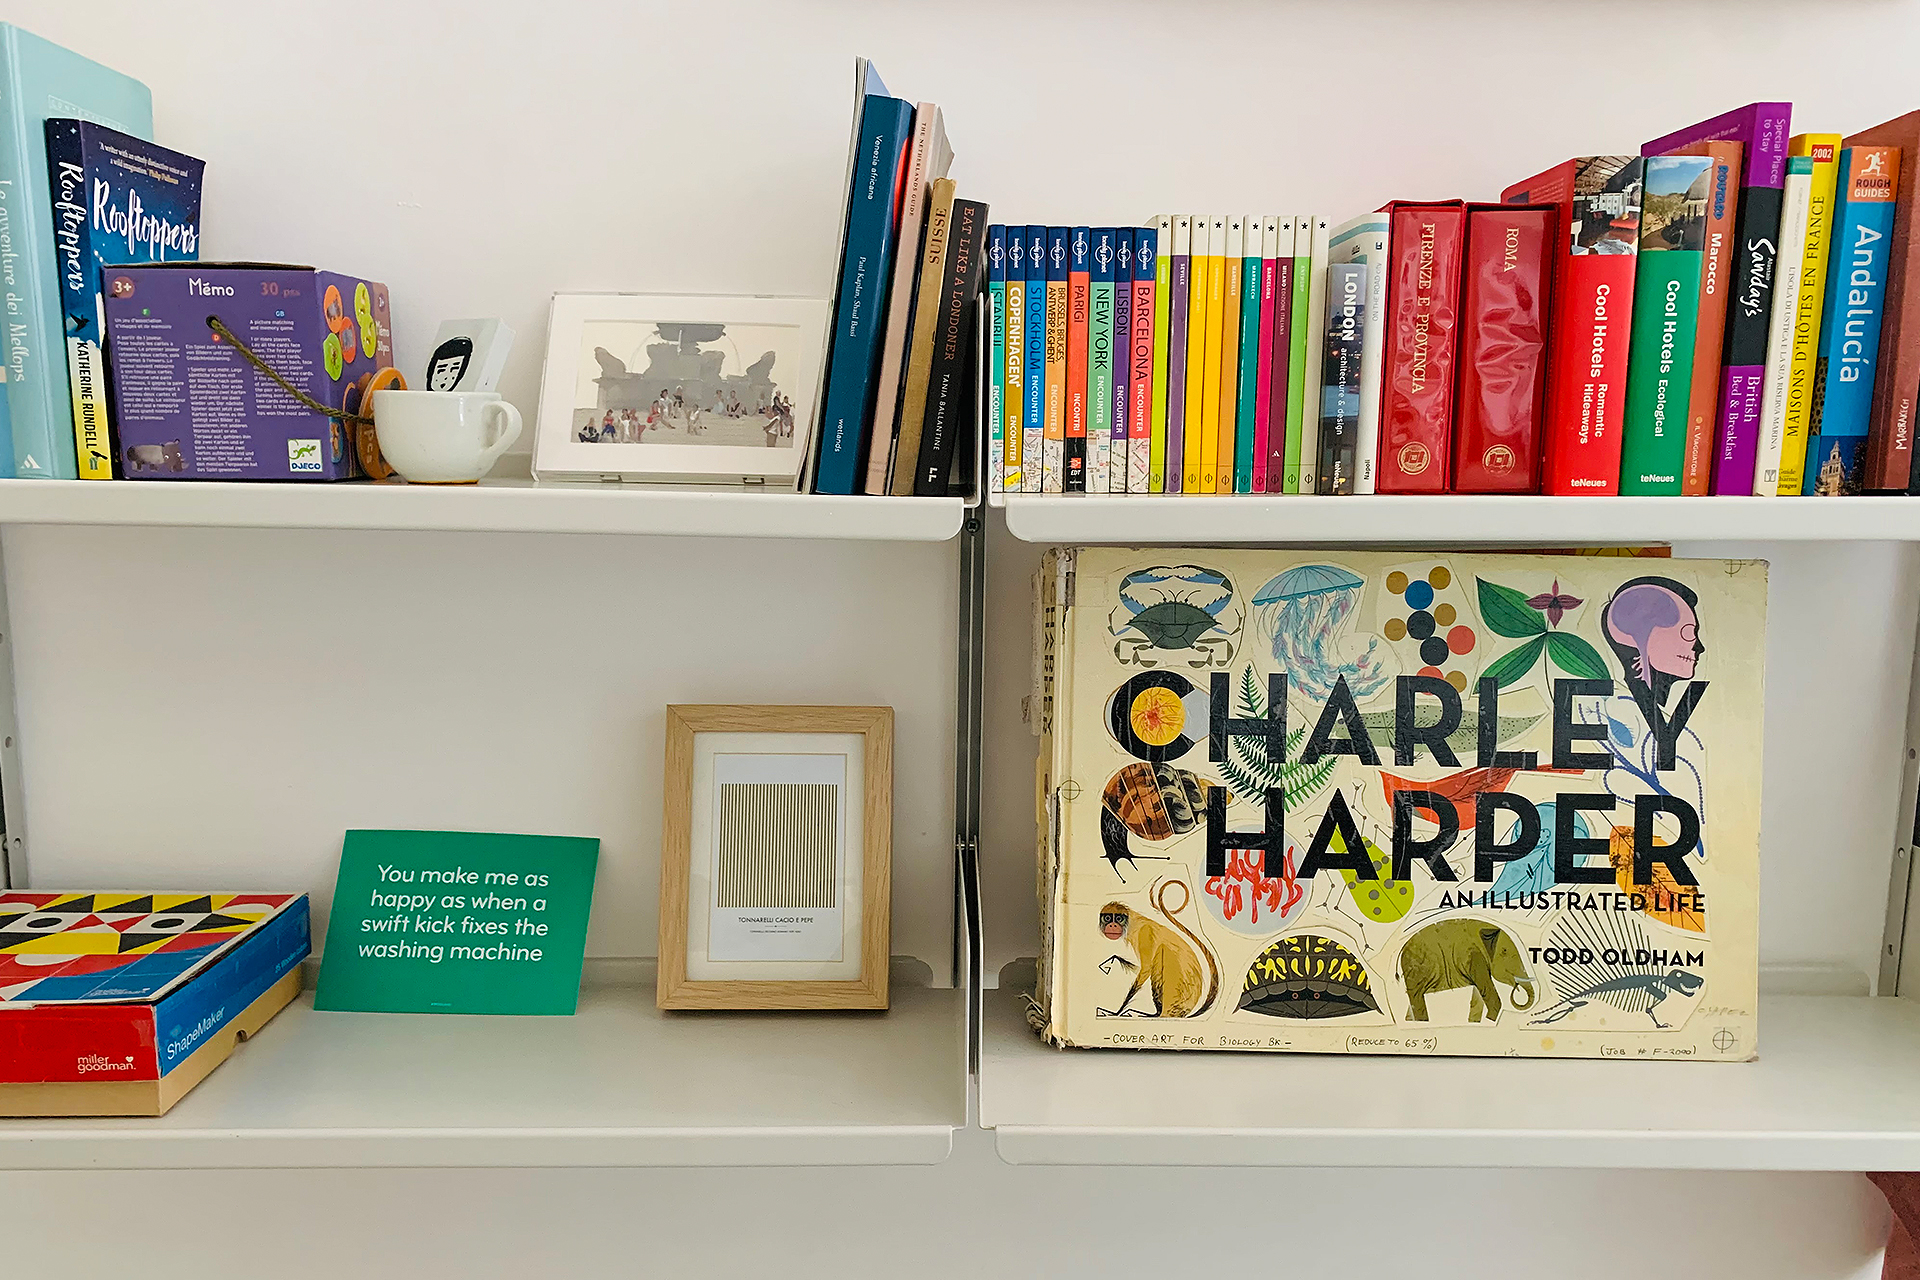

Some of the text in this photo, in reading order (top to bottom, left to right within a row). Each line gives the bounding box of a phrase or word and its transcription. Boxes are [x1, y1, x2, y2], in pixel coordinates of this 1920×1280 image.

[1759, 118, 1773, 153] to Stay
[1769, 118, 1786, 185] Special Places
[1812, 148, 1833, 159] 2002
[868, 134, 884, 200] Venezia africana
[913, 138, 924, 191] NETHERLANDS
[1855, 178, 1891, 188] ROUGH
[909, 193, 917, 217] GUIDE
[1854, 188, 1890, 198] GUIDES
[55, 161, 87, 296] Rooftoppers
[94, 177, 199, 262] Rooftoppers
[929, 207, 947, 265] SUISSE
[0, 207, 19, 286] avventure
[1503, 227, 1520, 273] ROMA
[1706, 233, 1723, 295] Marocco
[114, 280, 132, 294] 3+
[188, 277, 235, 297] Mémo
[260, 282, 279, 296] 30
[850, 256, 867, 338] Paul Kaplan, Shaul Bassi
[944, 206, 975, 361] EAT LIKE A LONDONER
[1373, 275, 1381, 295] ROAD
[1740, 237, 1776, 318] Sawday's
[6, 292, 23, 316] dei
[1047, 286, 1057, 328] ANTWERP
[1073, 285, 1085, 323] PARIGI
[1116, 288, 1129, 336] LISBON
[1341, 273, 1358, 341] LONDON
[1371, 310, 1379, 322] ON
[1411, 223, 1436, 394] FIRENZE E PROVINCIA
[1787, 195, 1824, 437] MAISONS D'HÔTES EN FRANCE
[1839, 224, 1882, 382] Andalucía
[1008, 286, 1021, 386] COPENHAGEN
[1029, 286, 1042, 370] STOCKHOLM
[1046, 335, 1055, 364] GHENT
[1094, 288, 1110, 370] NEW YORK
[1135, 287, 1150, 380] BARCELONA
[9, 323, 30, 382] Mellops
[1338, 347, 1348, 398] architecture
[1590, 284, 1610, 438] Cool Hotels Romantic
[1654, 280, 1681, 437] Cool Hotels Ecological
[76, 342, 98, 449] KATHERINE RUNDELL
[933, 373, 951, 451] TANIA BALLANTINE
[1031, 375, 1039, 424] ENCOUNTER
[1050, 384, 1058, 433] ENCOUNTER
[1073, 392, 1081, 431] INCONTRI
[1096, 375, 1105, 424] ENCOUNTER
[1115, 385, 1124, 434] ENCOUNTER
[1136, 383, 1145, 432] ENCOUNTER
[1579, 383, 1594, 445] Hideaways
[1724, 375, 1743, 460] Bed & Breakfast
[1743, 376, 1761, 422] British
[834, 418, 844, 453] wetlands
[1009, 415, 1017, 462] ENCOUNTER
[1335, 408, 1345, 435] design
[1770, 416, 1780, 450] MARINA
[1895, 398, 1910, 450] MARRAKECH
[291, 462, 321, 470] DJECO
[1363, 459, 1372, 481] Napoli
[1690, 433, 1702, 476] VIAGGIATORE
[1570, 478, 1607, 488] teNeues
[1640, 474, 1675, 484] teNeues
[1110, 670, 1710, 773] CHARLEY
[1204, 785, 1706, 887] HARPER
[377, 864, 549, 887] You make me as
[370, 889, 547, 912] happy as when a
[1438, 890, 1706, 913] AN ILLUSTRATED LIFE
[360, 914, 549, 936] swift kick fixes the
[358, 940, 543, 963] washing machine
[1528, 947, 1704, 967] TODD OLDHAM
[166, 1005, 226, 1061] ShapeMaker
[1151, 1034, 1262, 1047] ART FOR BIOLOGY
[1345, 1034, 1386, 1053] (REDUCE
[1404, 1038, 1419, 1048] 65
[1637, 1047, 1647, 1055] #
[77, 1053, 109, 1065] miller
[77, 1060, 136, 1074] goodman.
